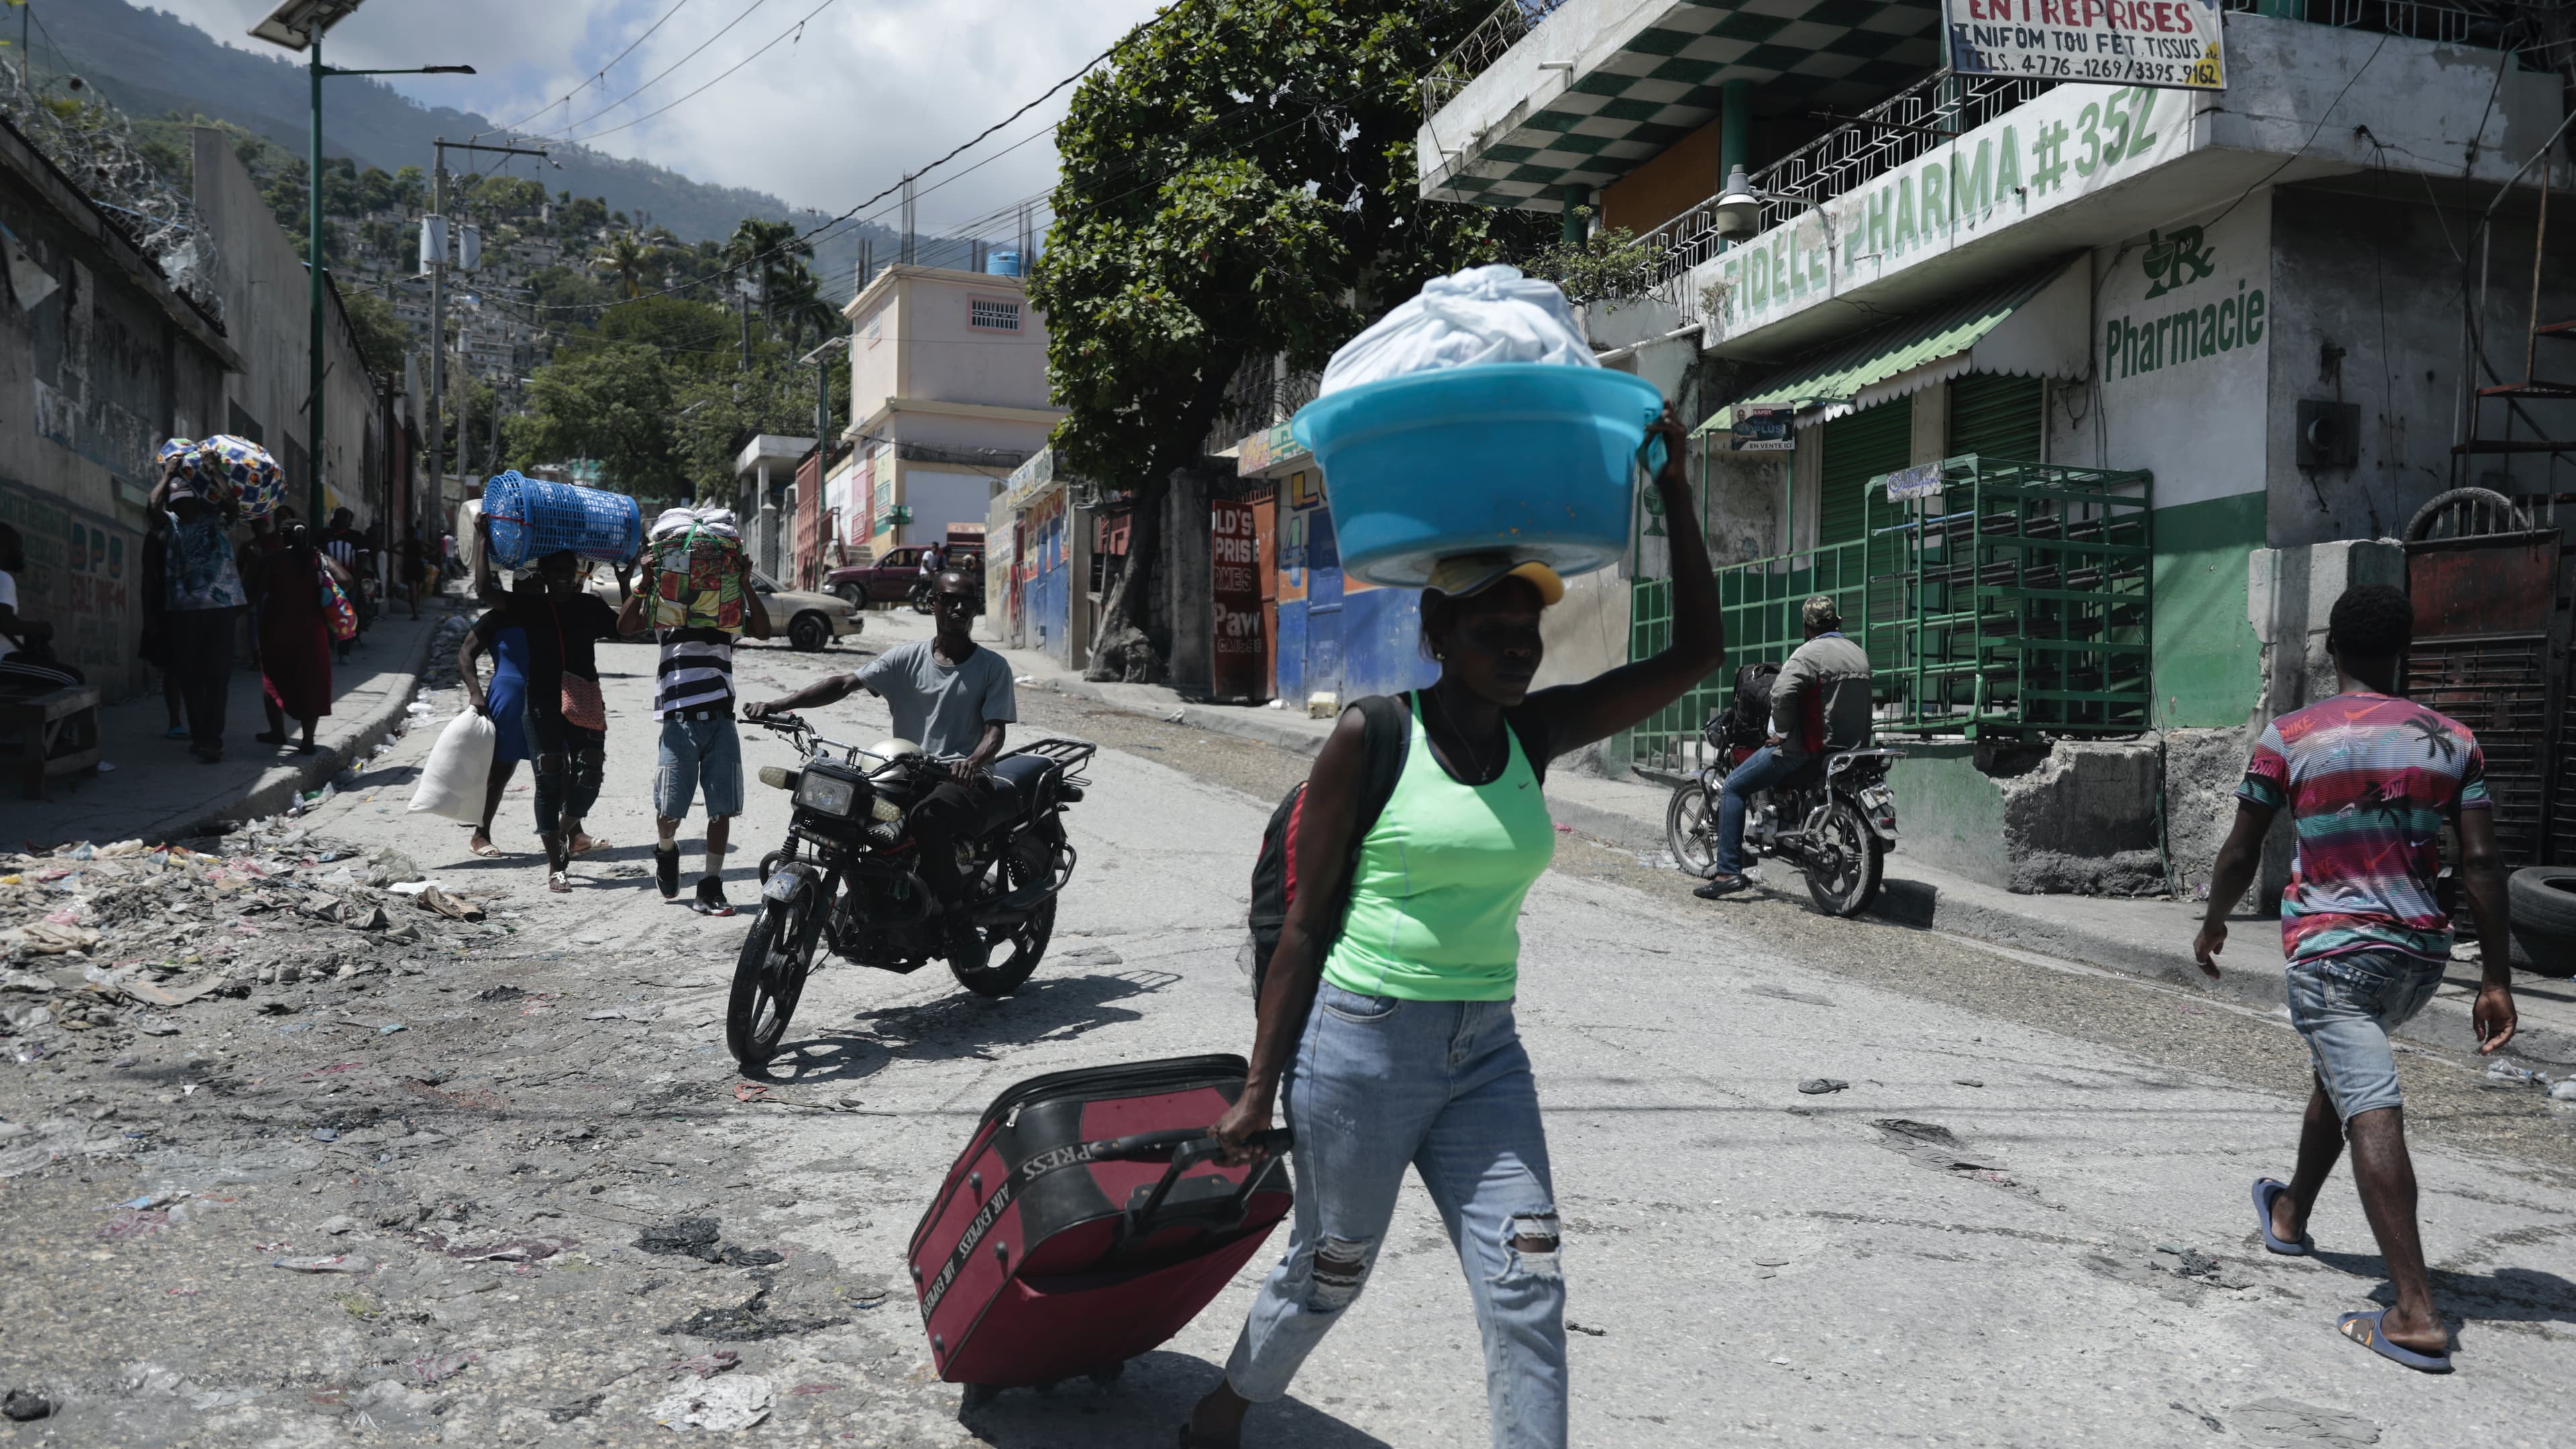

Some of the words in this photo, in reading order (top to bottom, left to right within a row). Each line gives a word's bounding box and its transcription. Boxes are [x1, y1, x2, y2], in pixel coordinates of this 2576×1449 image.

[1962, 48, 2015, 72] TELS.
[2051, 31, 2088, 52] TOU
[2144, 37, 2201, 59] TISSUS
[1844, 124, 2023, 276] PHARMA
[2106, 278, 2265, 382] Pharmacie
[2280, 714, 2311, 738] NIKE
[990, 1182, 1010, 1215] AIR
[958, 1205, 993, 1260] EXPRESS
[942, 1256, 955, 1285] AIR
[922, 1275, 945, 1320] EXPRESS
